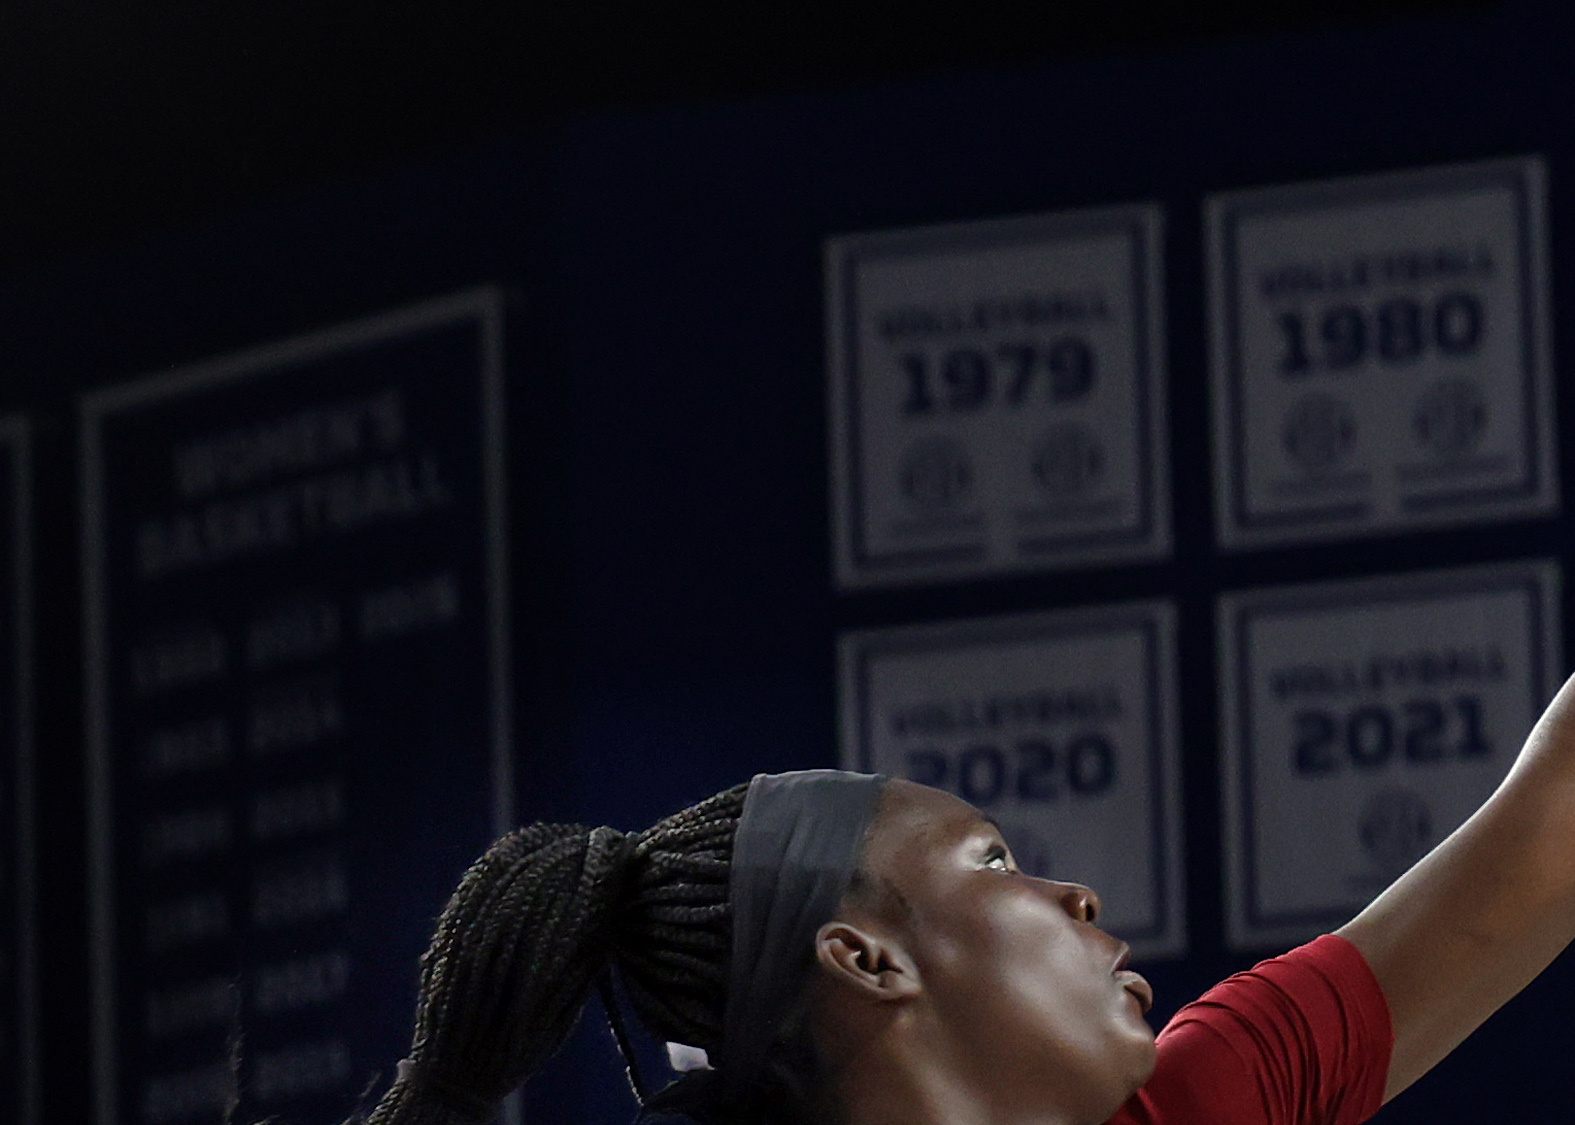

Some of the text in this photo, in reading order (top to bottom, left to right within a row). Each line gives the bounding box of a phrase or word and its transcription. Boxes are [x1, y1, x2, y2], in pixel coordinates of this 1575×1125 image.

[1260, 246, 1495, 298] VOLLEYBALL
[879, 293, 1108, 342] VOLLEYBALL
[1277, 291, 1484, 380] 1980
[901, 334, 1098, 416] 1979
[1270, 648, 1505, 699] VOLLEYBALL
[890, 686, 1122, 738] VOLLEYBALL
[1292, 693, 1494, 779] 2021
